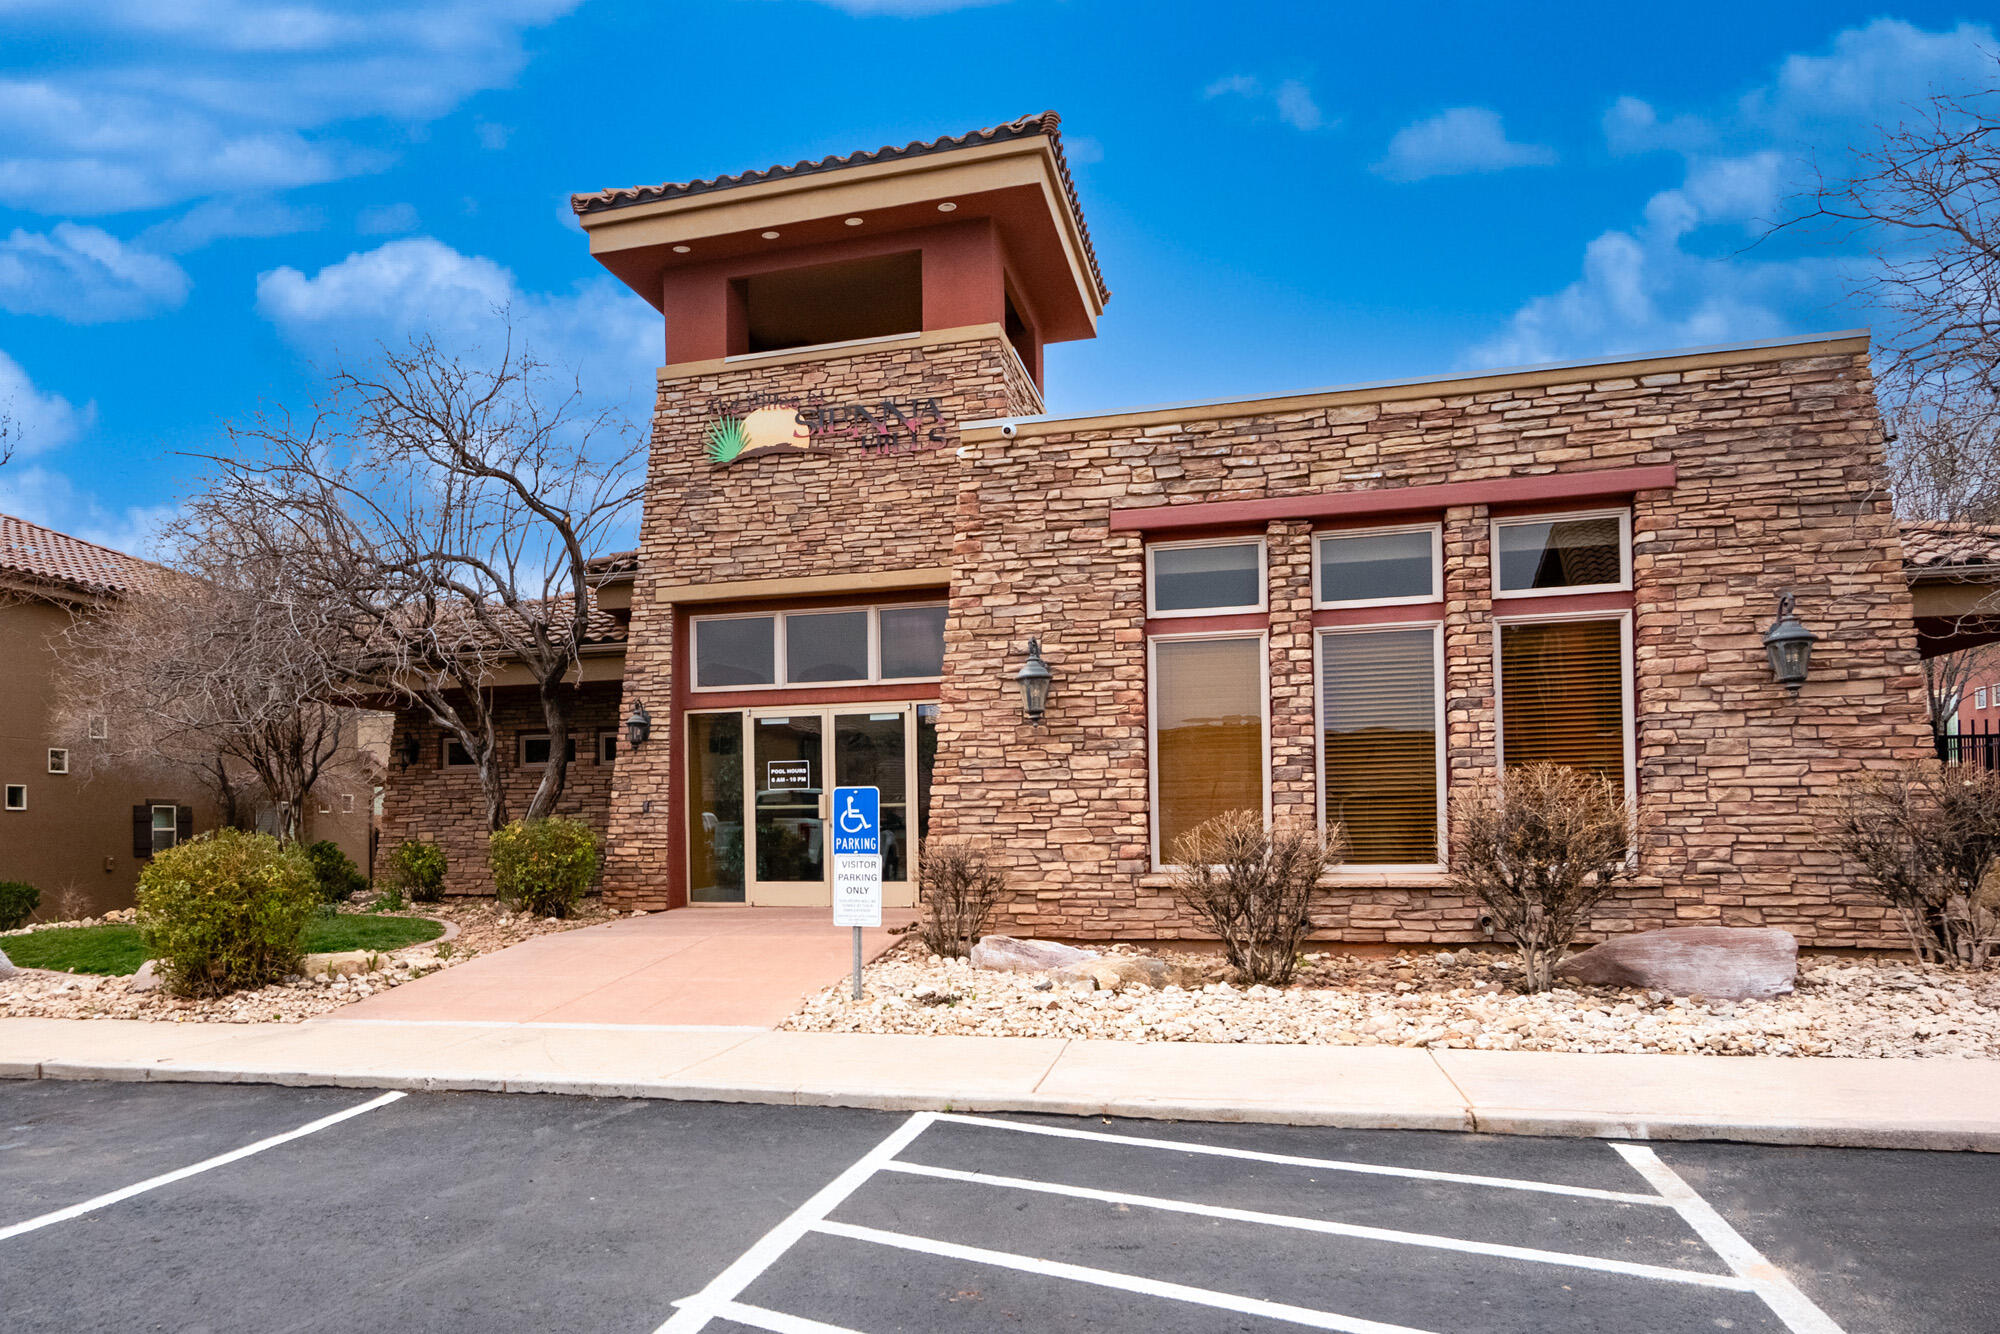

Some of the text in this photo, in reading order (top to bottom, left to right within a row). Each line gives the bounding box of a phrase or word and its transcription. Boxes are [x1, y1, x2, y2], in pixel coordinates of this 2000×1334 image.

[793, 398, 946, 438] SIENNA
[860, 427, 947, 457] HILLS
[835, 837, 877, 850] PARKING
[846, 886, 870, 894] ONLY
